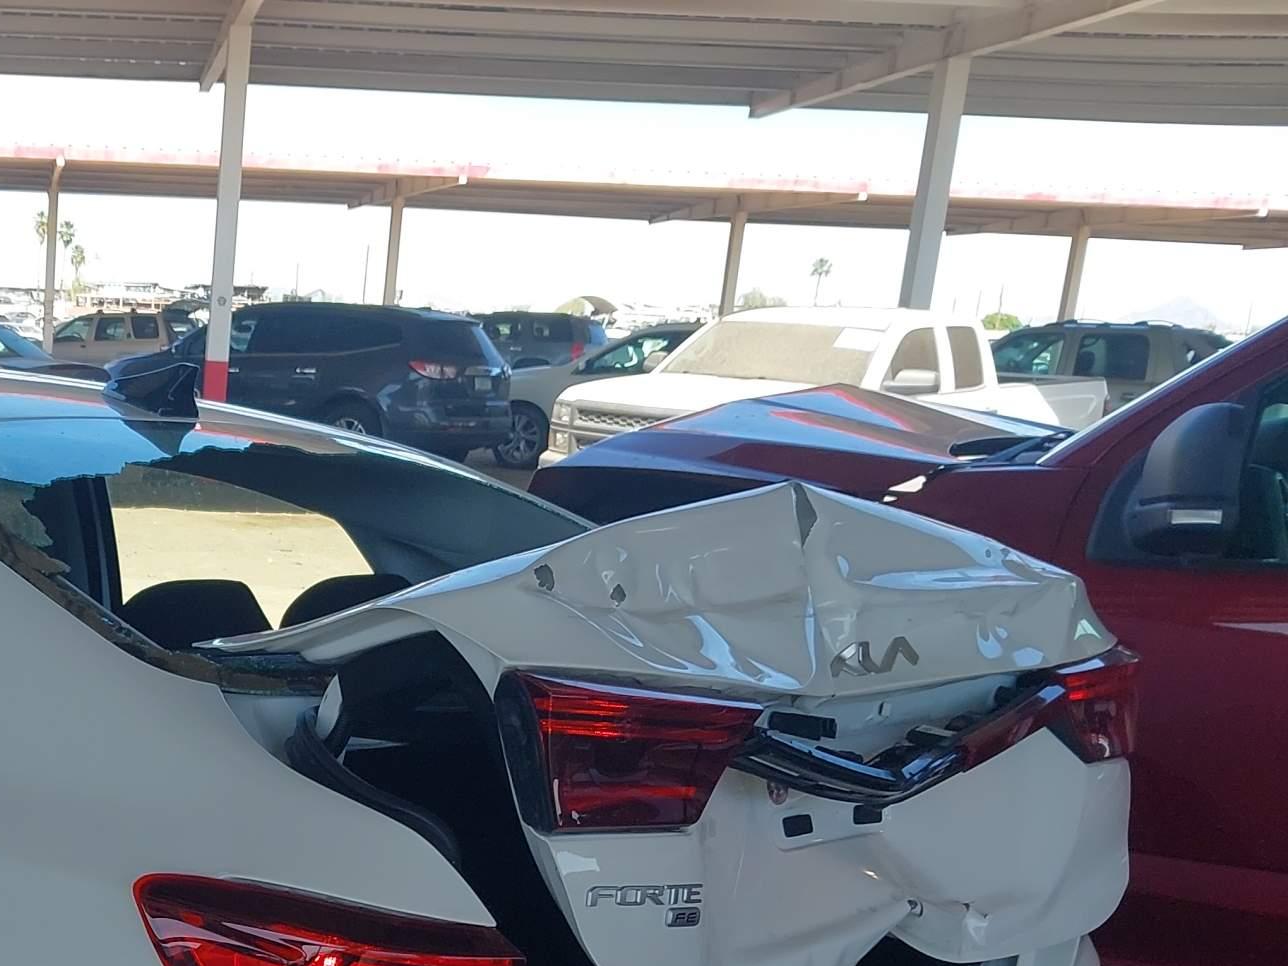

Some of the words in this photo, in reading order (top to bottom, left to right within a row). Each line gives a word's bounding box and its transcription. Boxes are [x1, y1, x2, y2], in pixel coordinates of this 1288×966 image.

[830, 636, 919, 677] KIA
[586, 884, 703, 907] FORTE
[672, 910, 699, 925] FE
